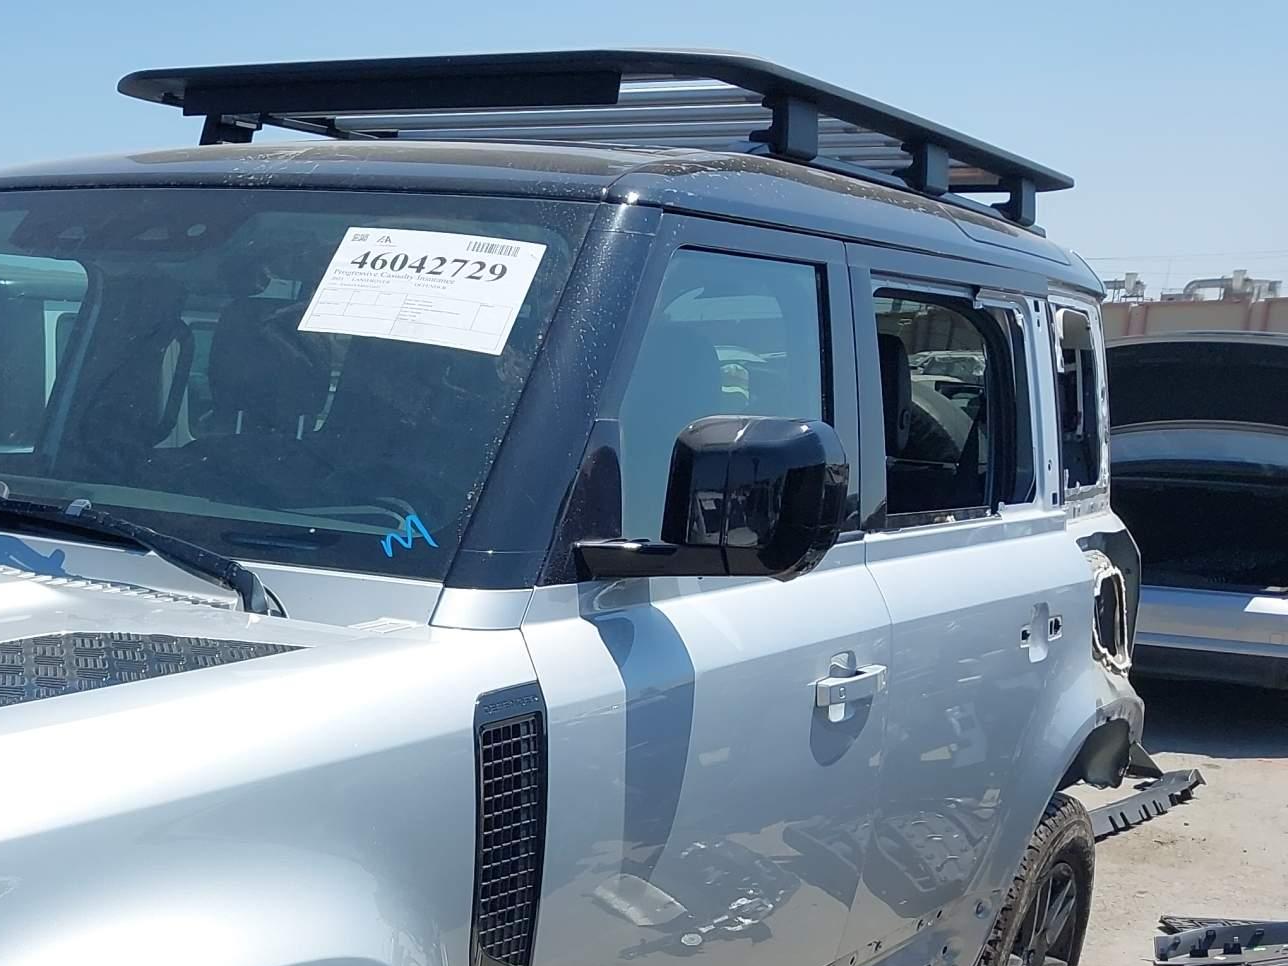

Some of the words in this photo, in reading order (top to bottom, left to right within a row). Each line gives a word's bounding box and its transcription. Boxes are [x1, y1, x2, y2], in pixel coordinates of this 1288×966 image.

[333, 268, 378, 278] Progressive
[416, 274, 456, 285] Insurance
[350, 250, 508, 282] 46042729
